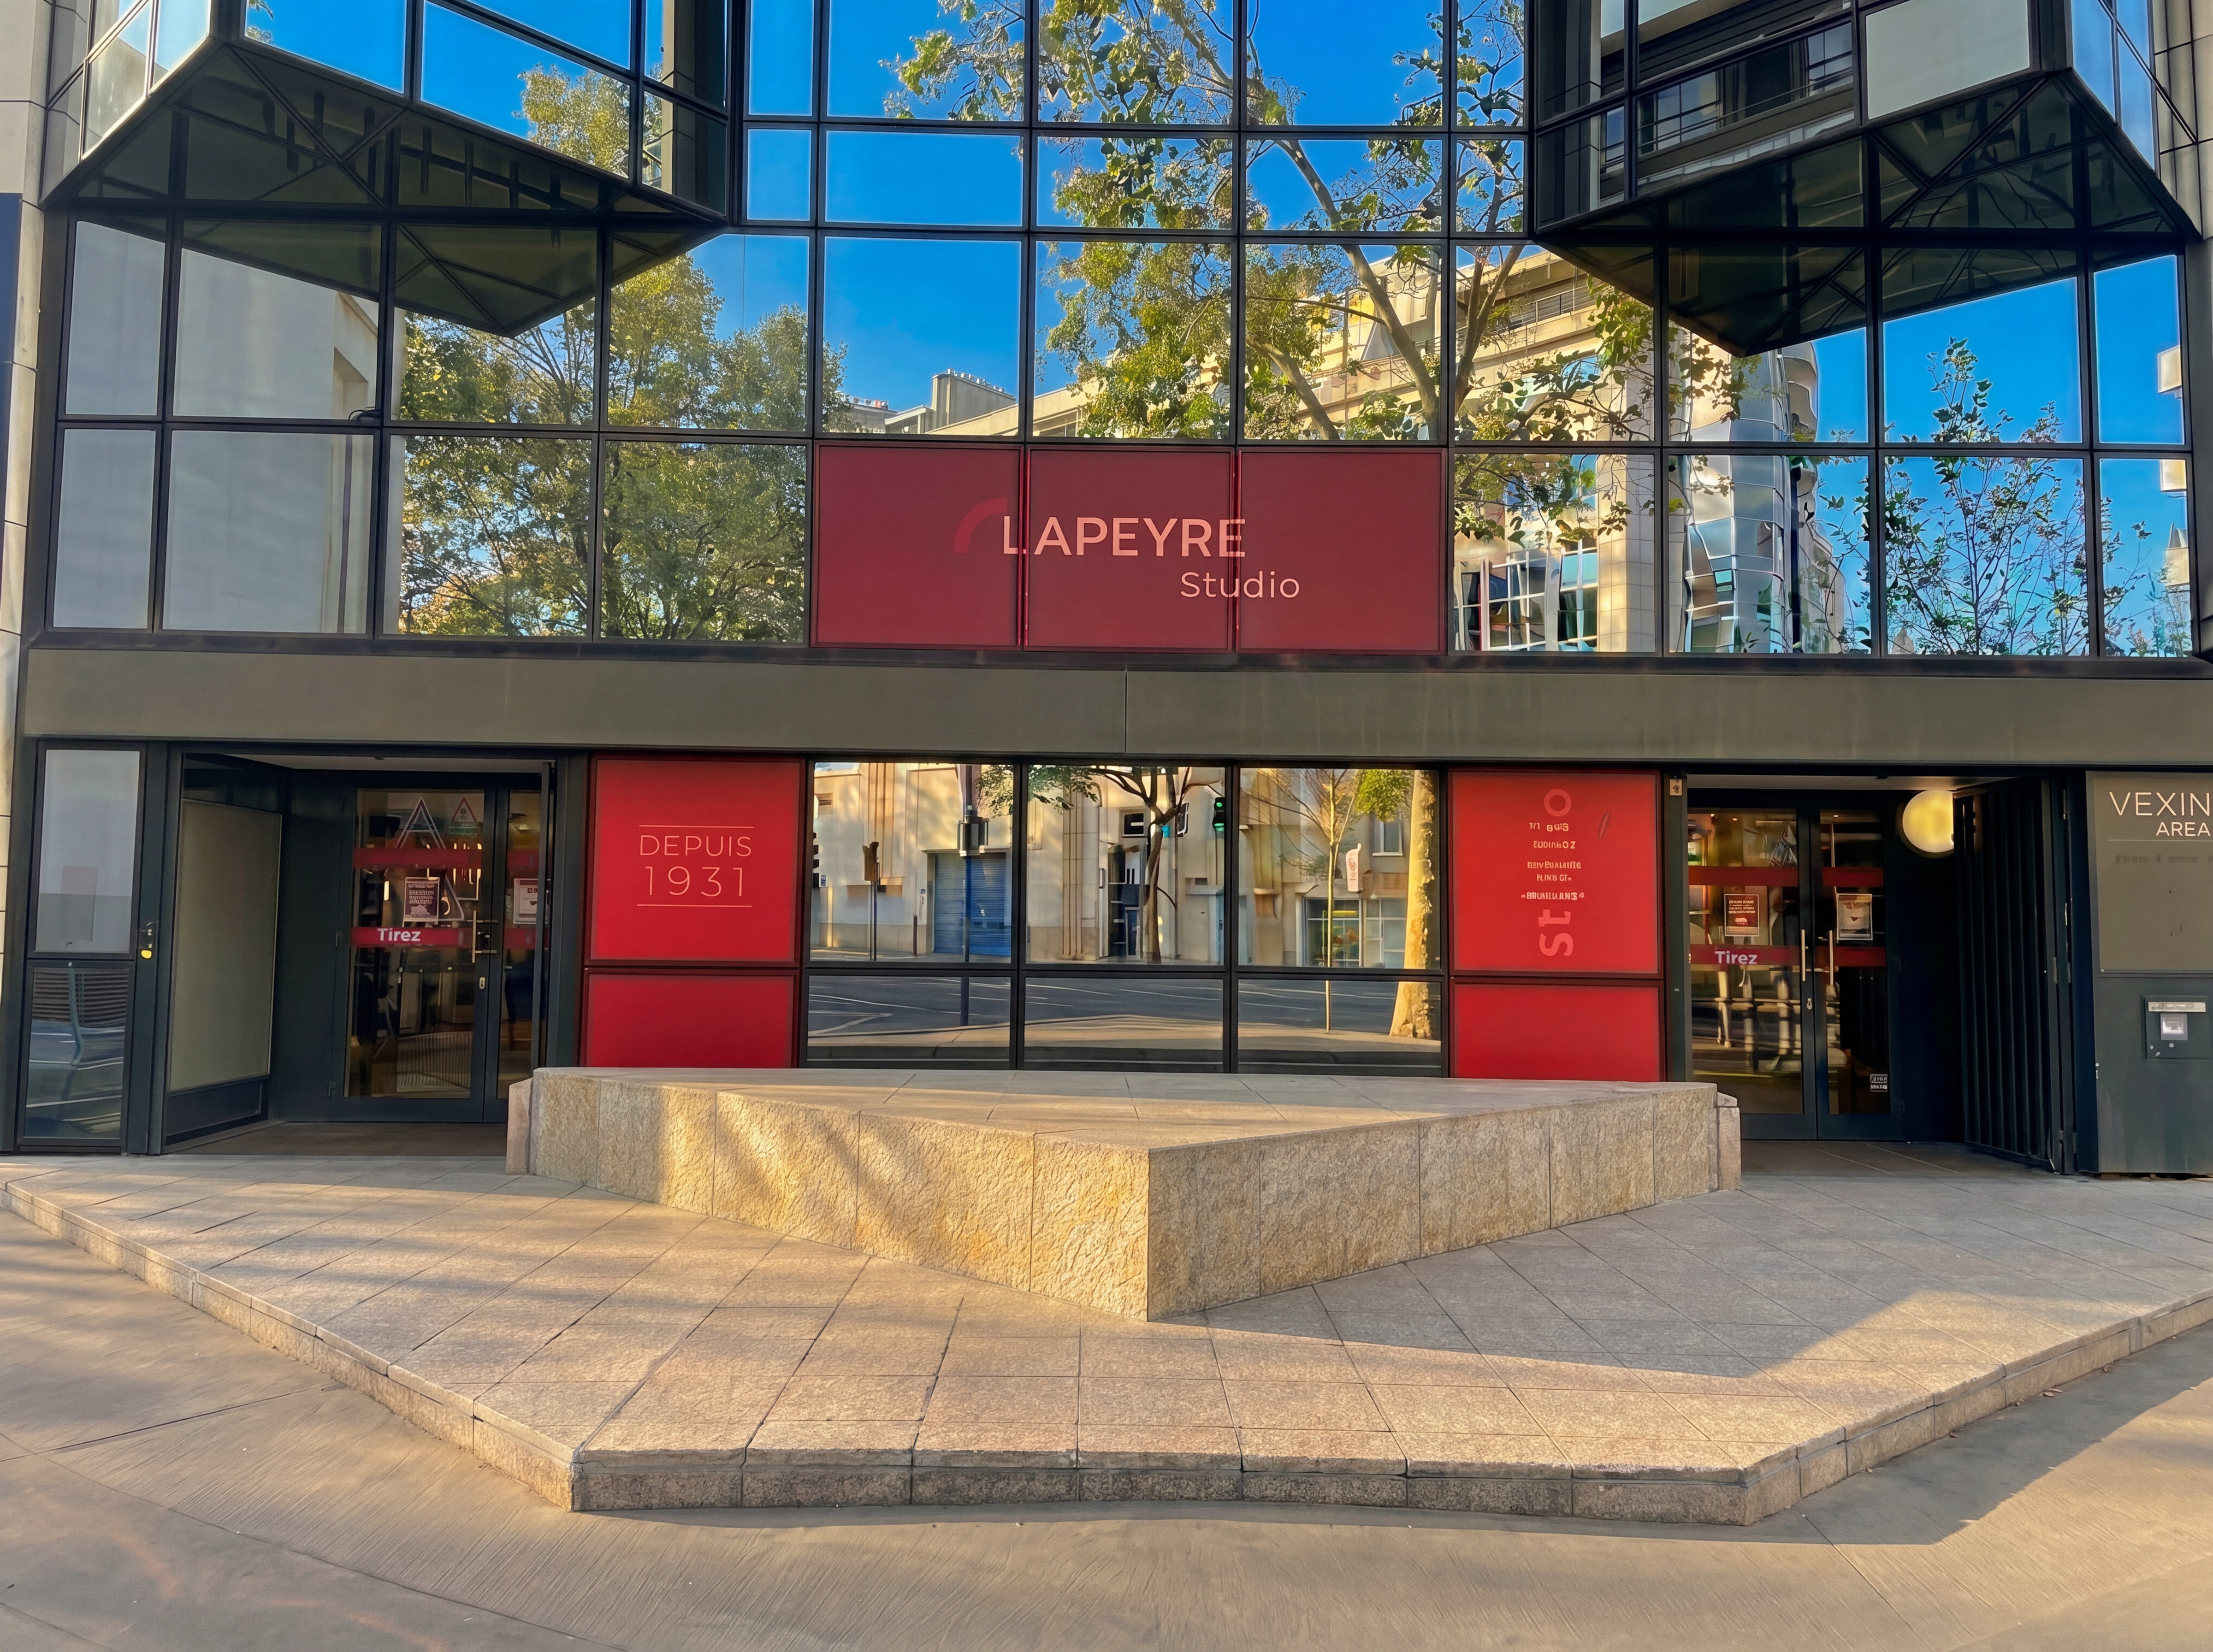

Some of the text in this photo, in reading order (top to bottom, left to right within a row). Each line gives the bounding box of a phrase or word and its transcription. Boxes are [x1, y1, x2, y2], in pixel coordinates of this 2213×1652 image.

[1003, 516, 1246, 557] LAPEYRE
[1180, 571, 1300, 599] Studio
[2108, 791, 2210, 816] VEXIN
[2155, 821, 2211, 837] AREA
[639, 834, 752, 857] DEPUIS
[645, 866, 743, 897] 1931
[377, 927, 421, 942] Tirez
[1714, 950, 1758, 965] Tirez
